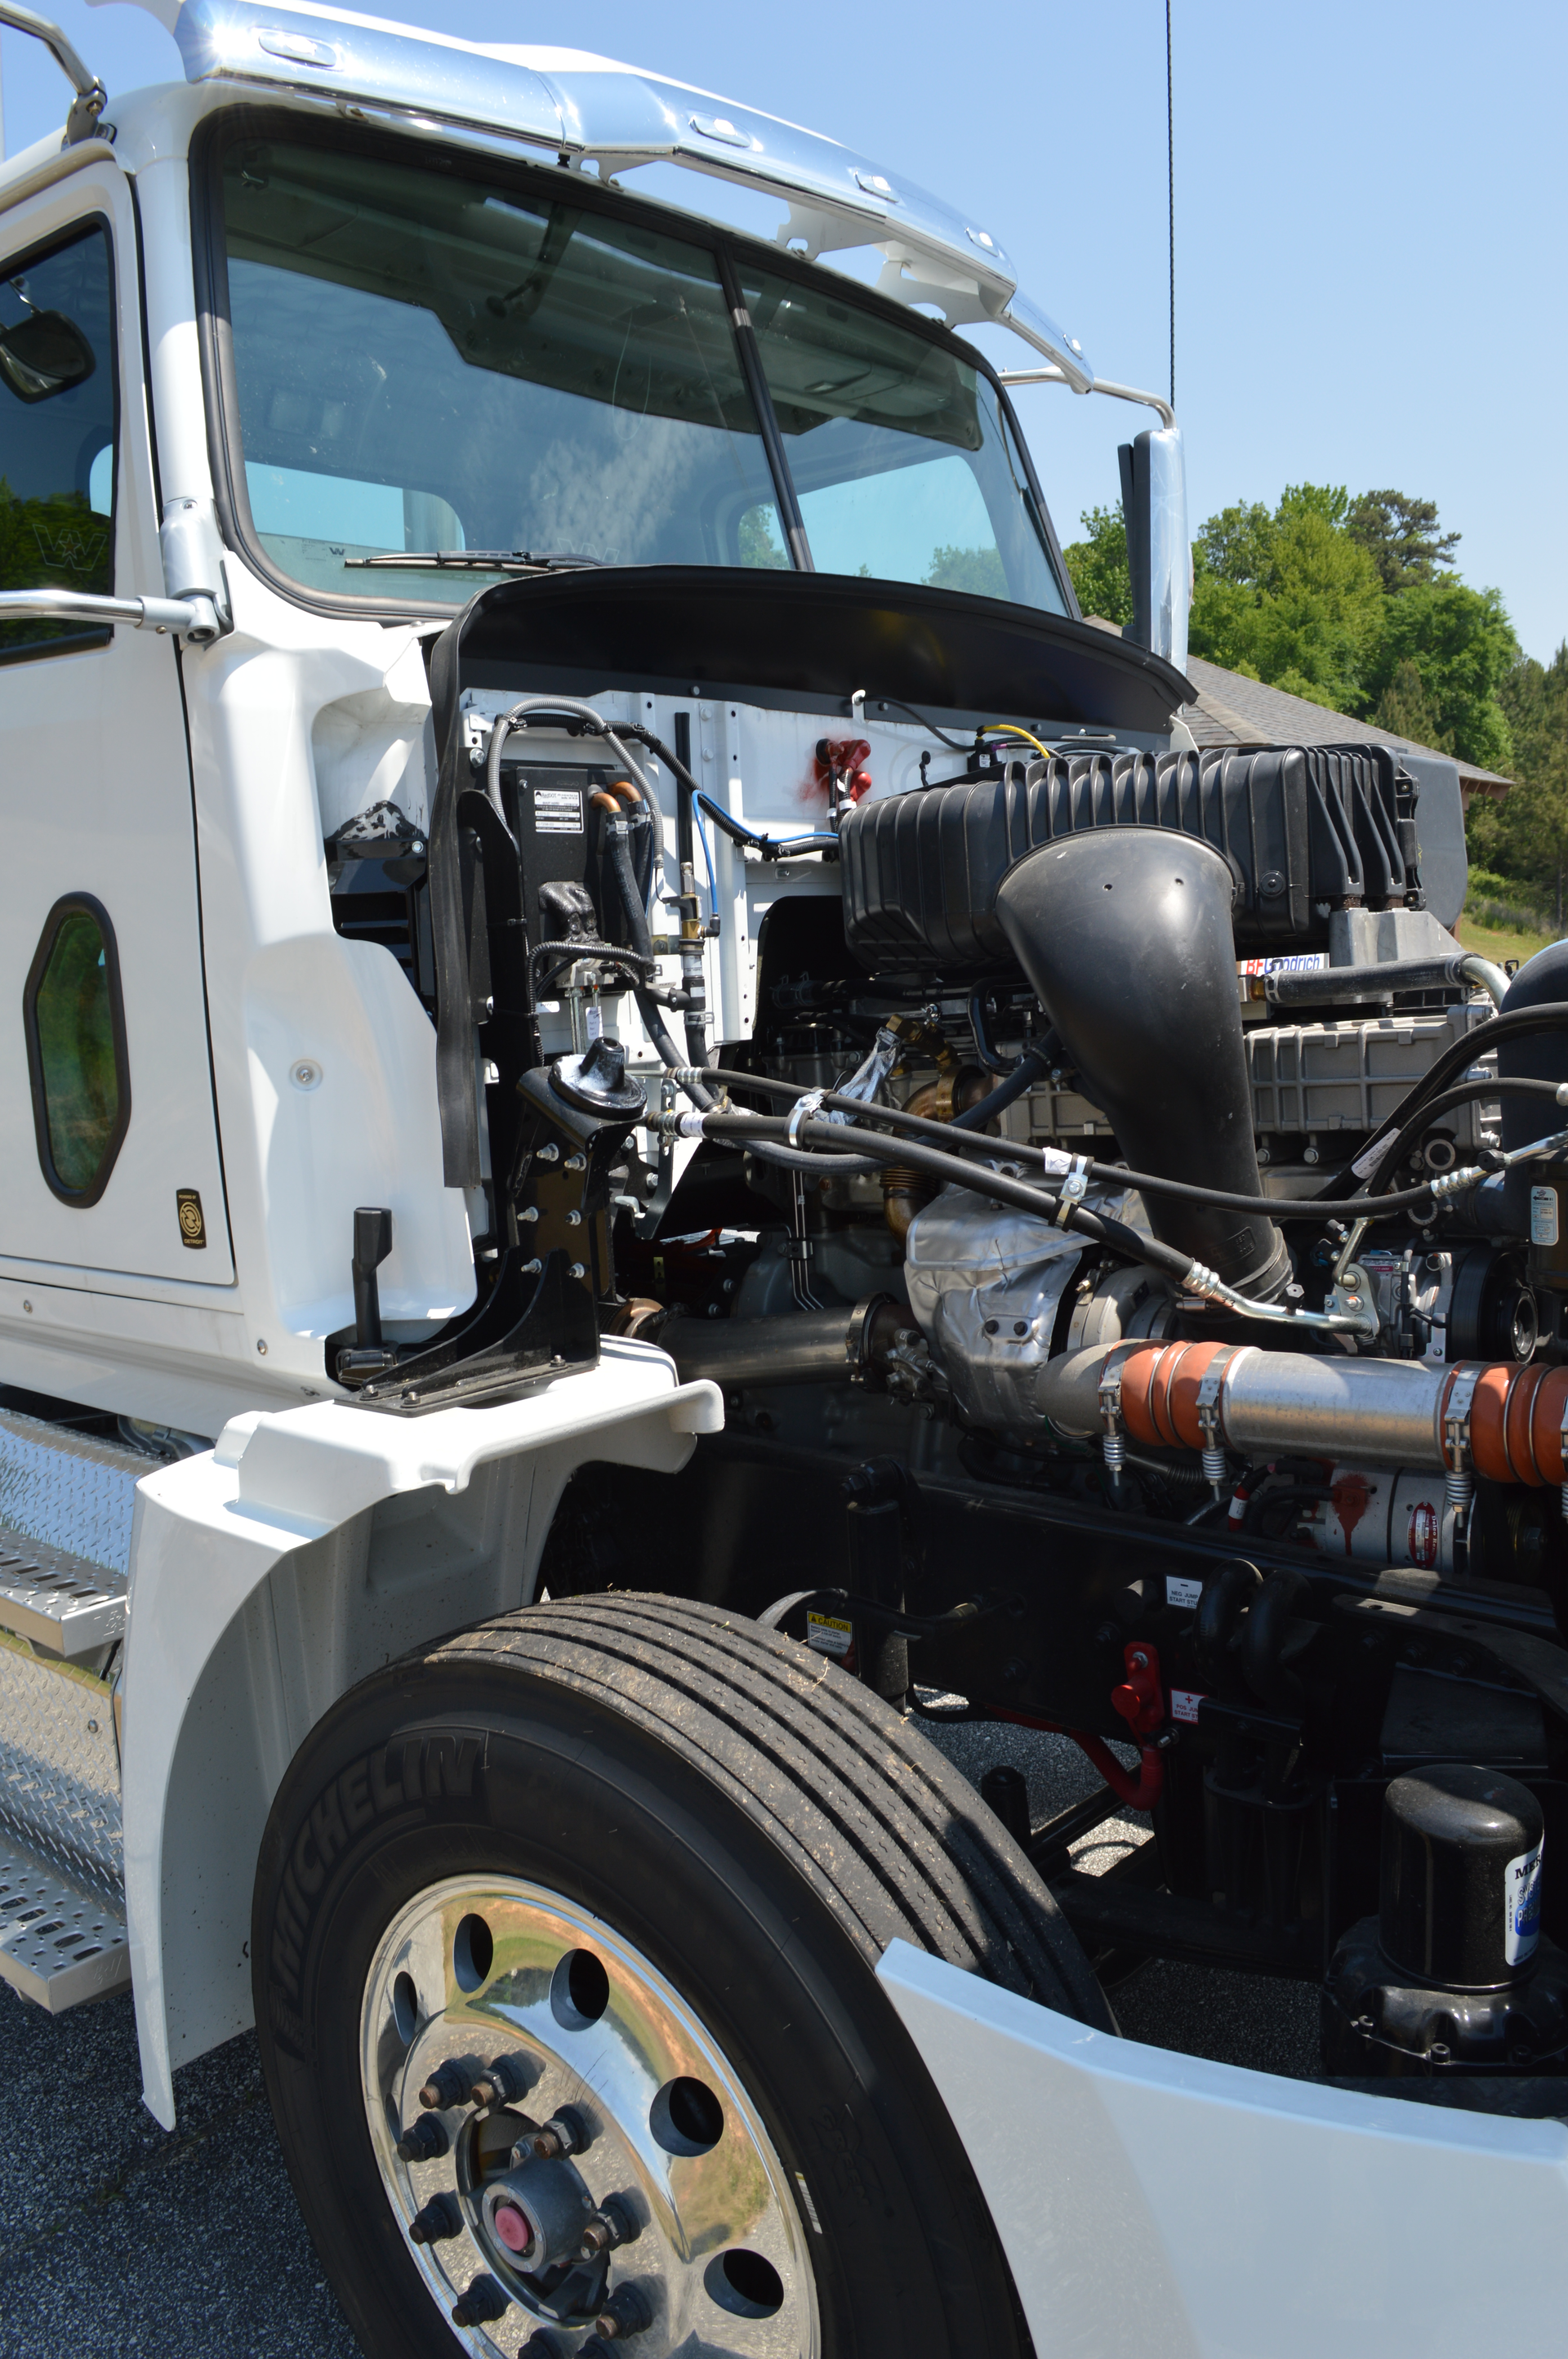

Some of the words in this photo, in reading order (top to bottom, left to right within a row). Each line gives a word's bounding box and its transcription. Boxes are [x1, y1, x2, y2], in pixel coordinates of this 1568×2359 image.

[817, 1617, 849, 1631] CAUTION
[270, 1735, 482, 1997] MICHELIN
[1515, 1853, 1543, 1880] MER
